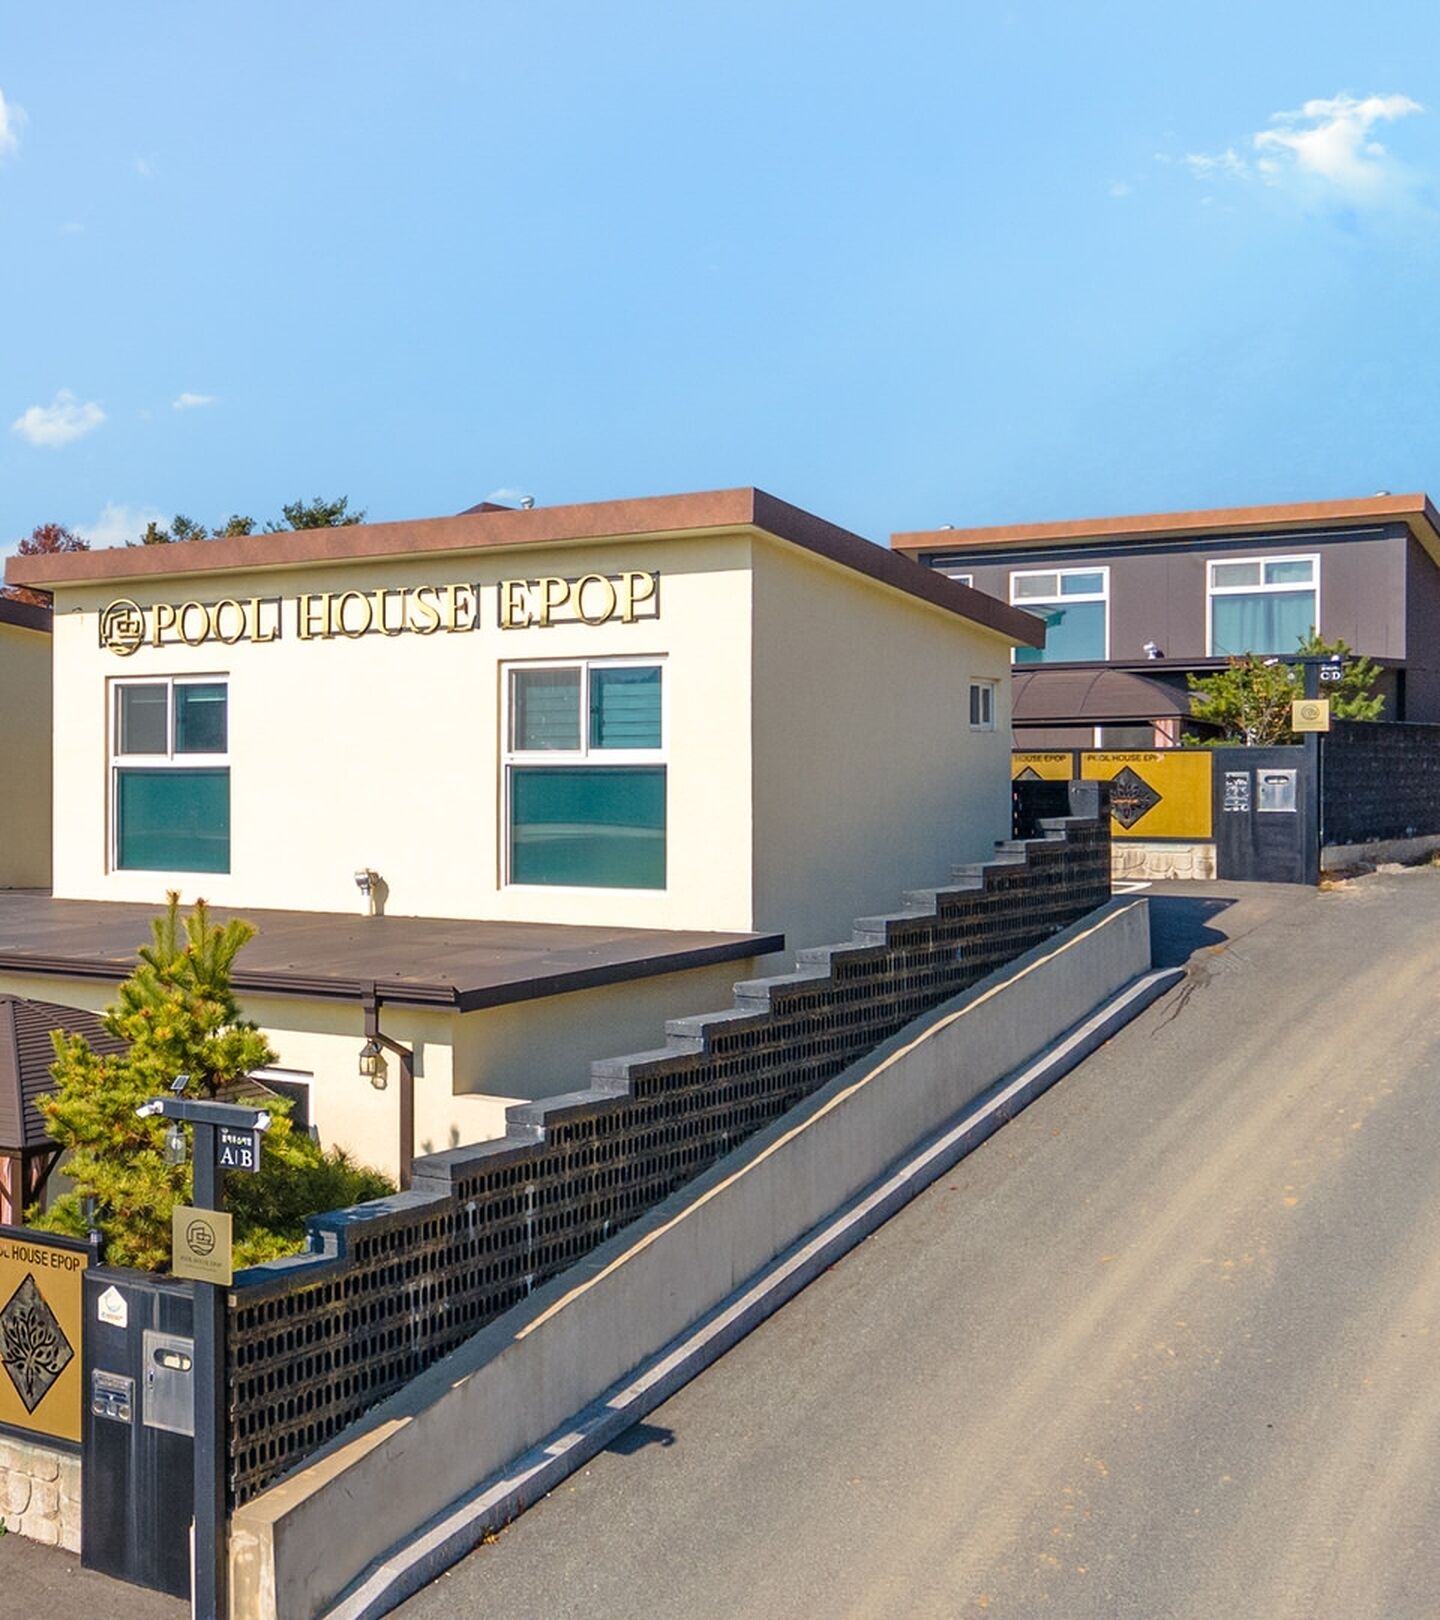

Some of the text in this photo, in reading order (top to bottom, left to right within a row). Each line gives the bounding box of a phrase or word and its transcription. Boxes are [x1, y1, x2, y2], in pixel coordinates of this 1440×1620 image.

[151, 571, 656, 648] POOL HOUSE EPOP
[1112, 754, 1140, 762] HOUSE
[11, 1244, 49, 1267] HOUSE
[50, 1253, 81, 1272] EPOP
